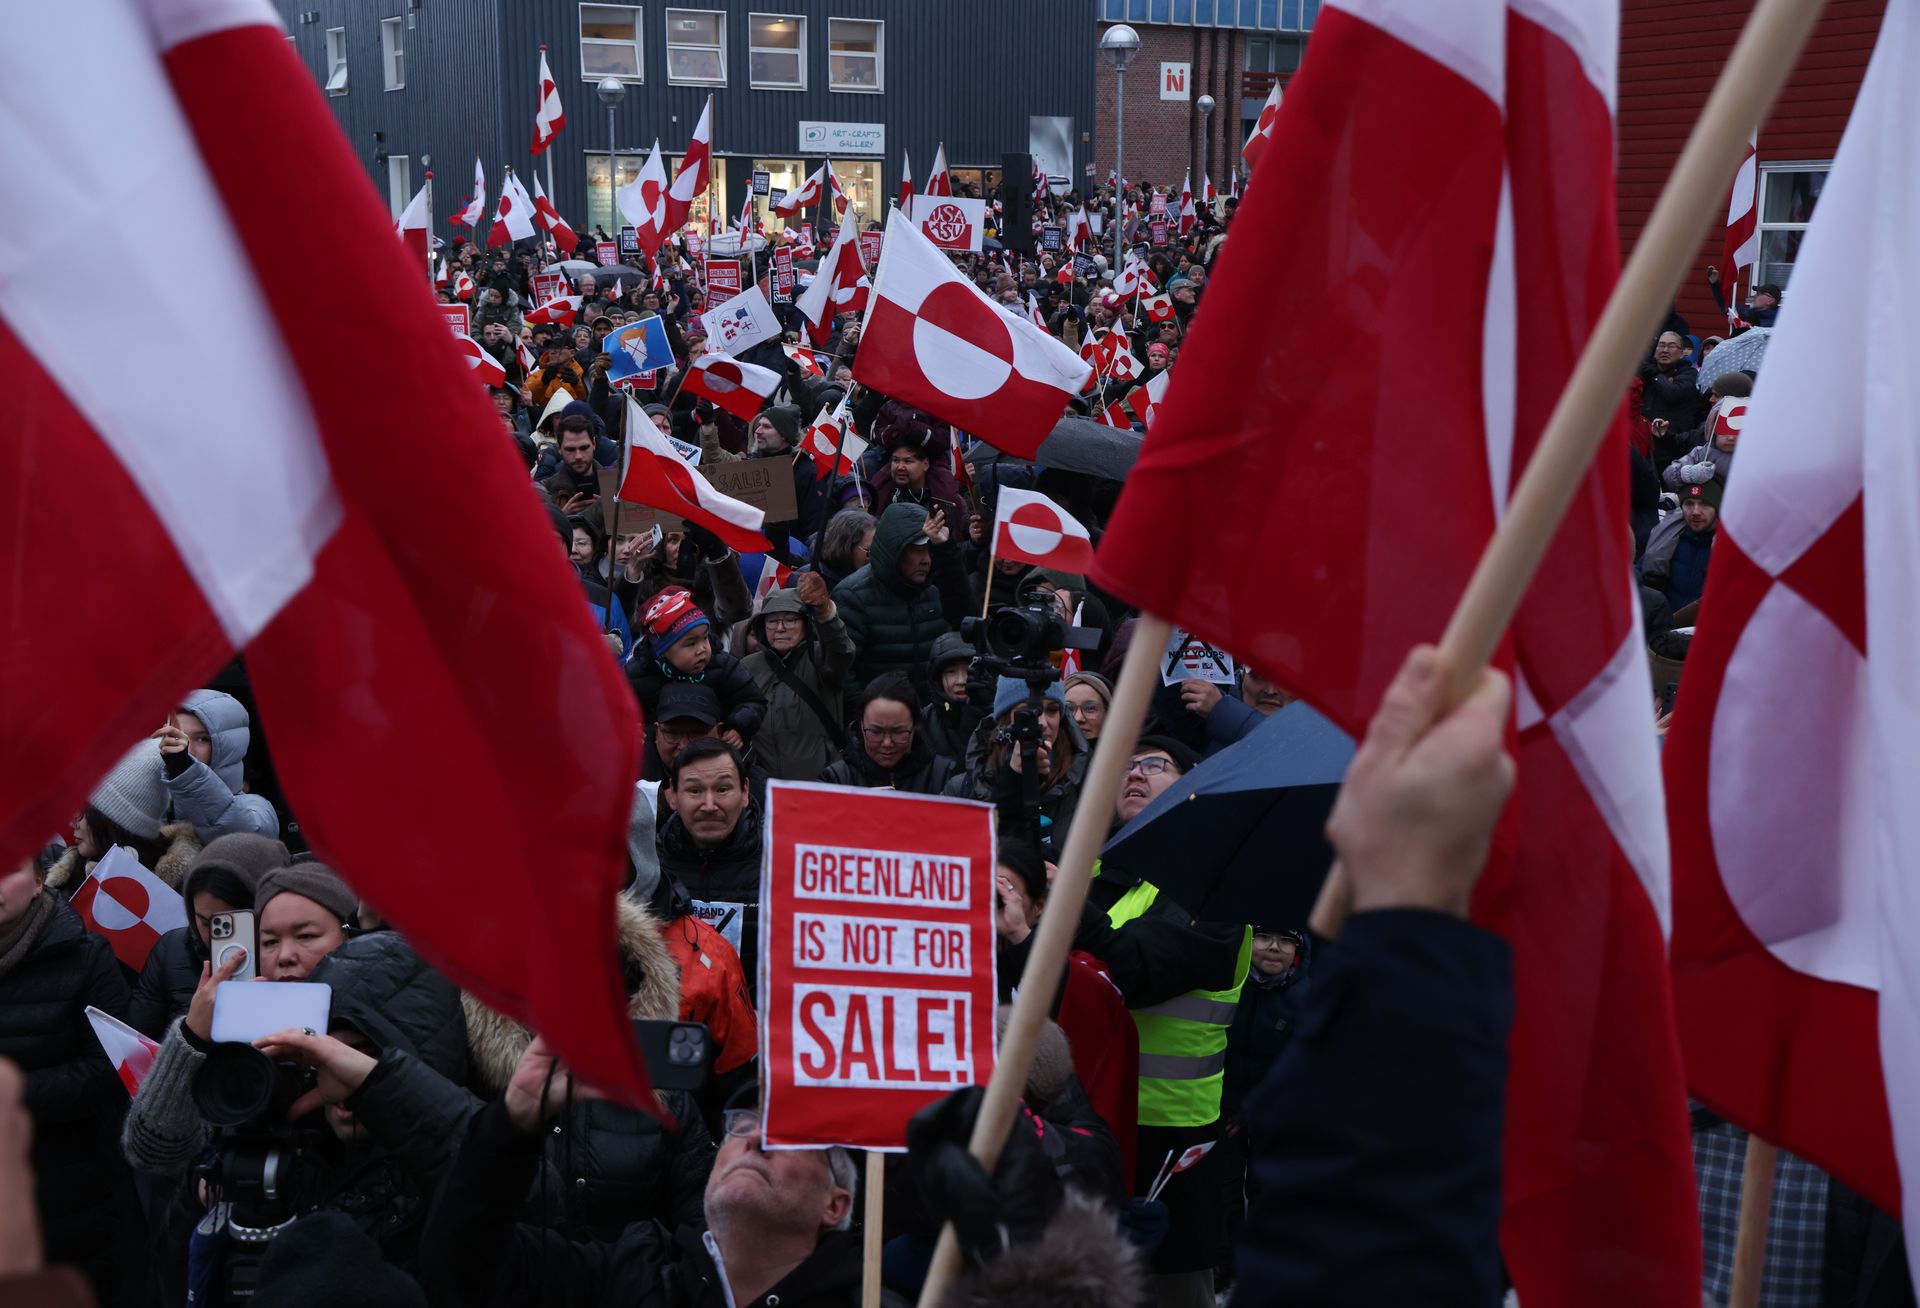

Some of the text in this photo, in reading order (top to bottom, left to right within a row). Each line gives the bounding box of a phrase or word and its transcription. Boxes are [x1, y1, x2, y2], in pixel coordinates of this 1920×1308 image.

[832, 129, 881, 138] ART CRAFTS
[840, 140, 874, 148] GALLERY
[931, 205, 965, 225] USA
[719, 468, 772, 492] SALE!
[800, 850, 965, 902] GREENLAND
[799, 920, 965, 970] IS NOT FOR
[799, 990, 969, 1084] SALE!
